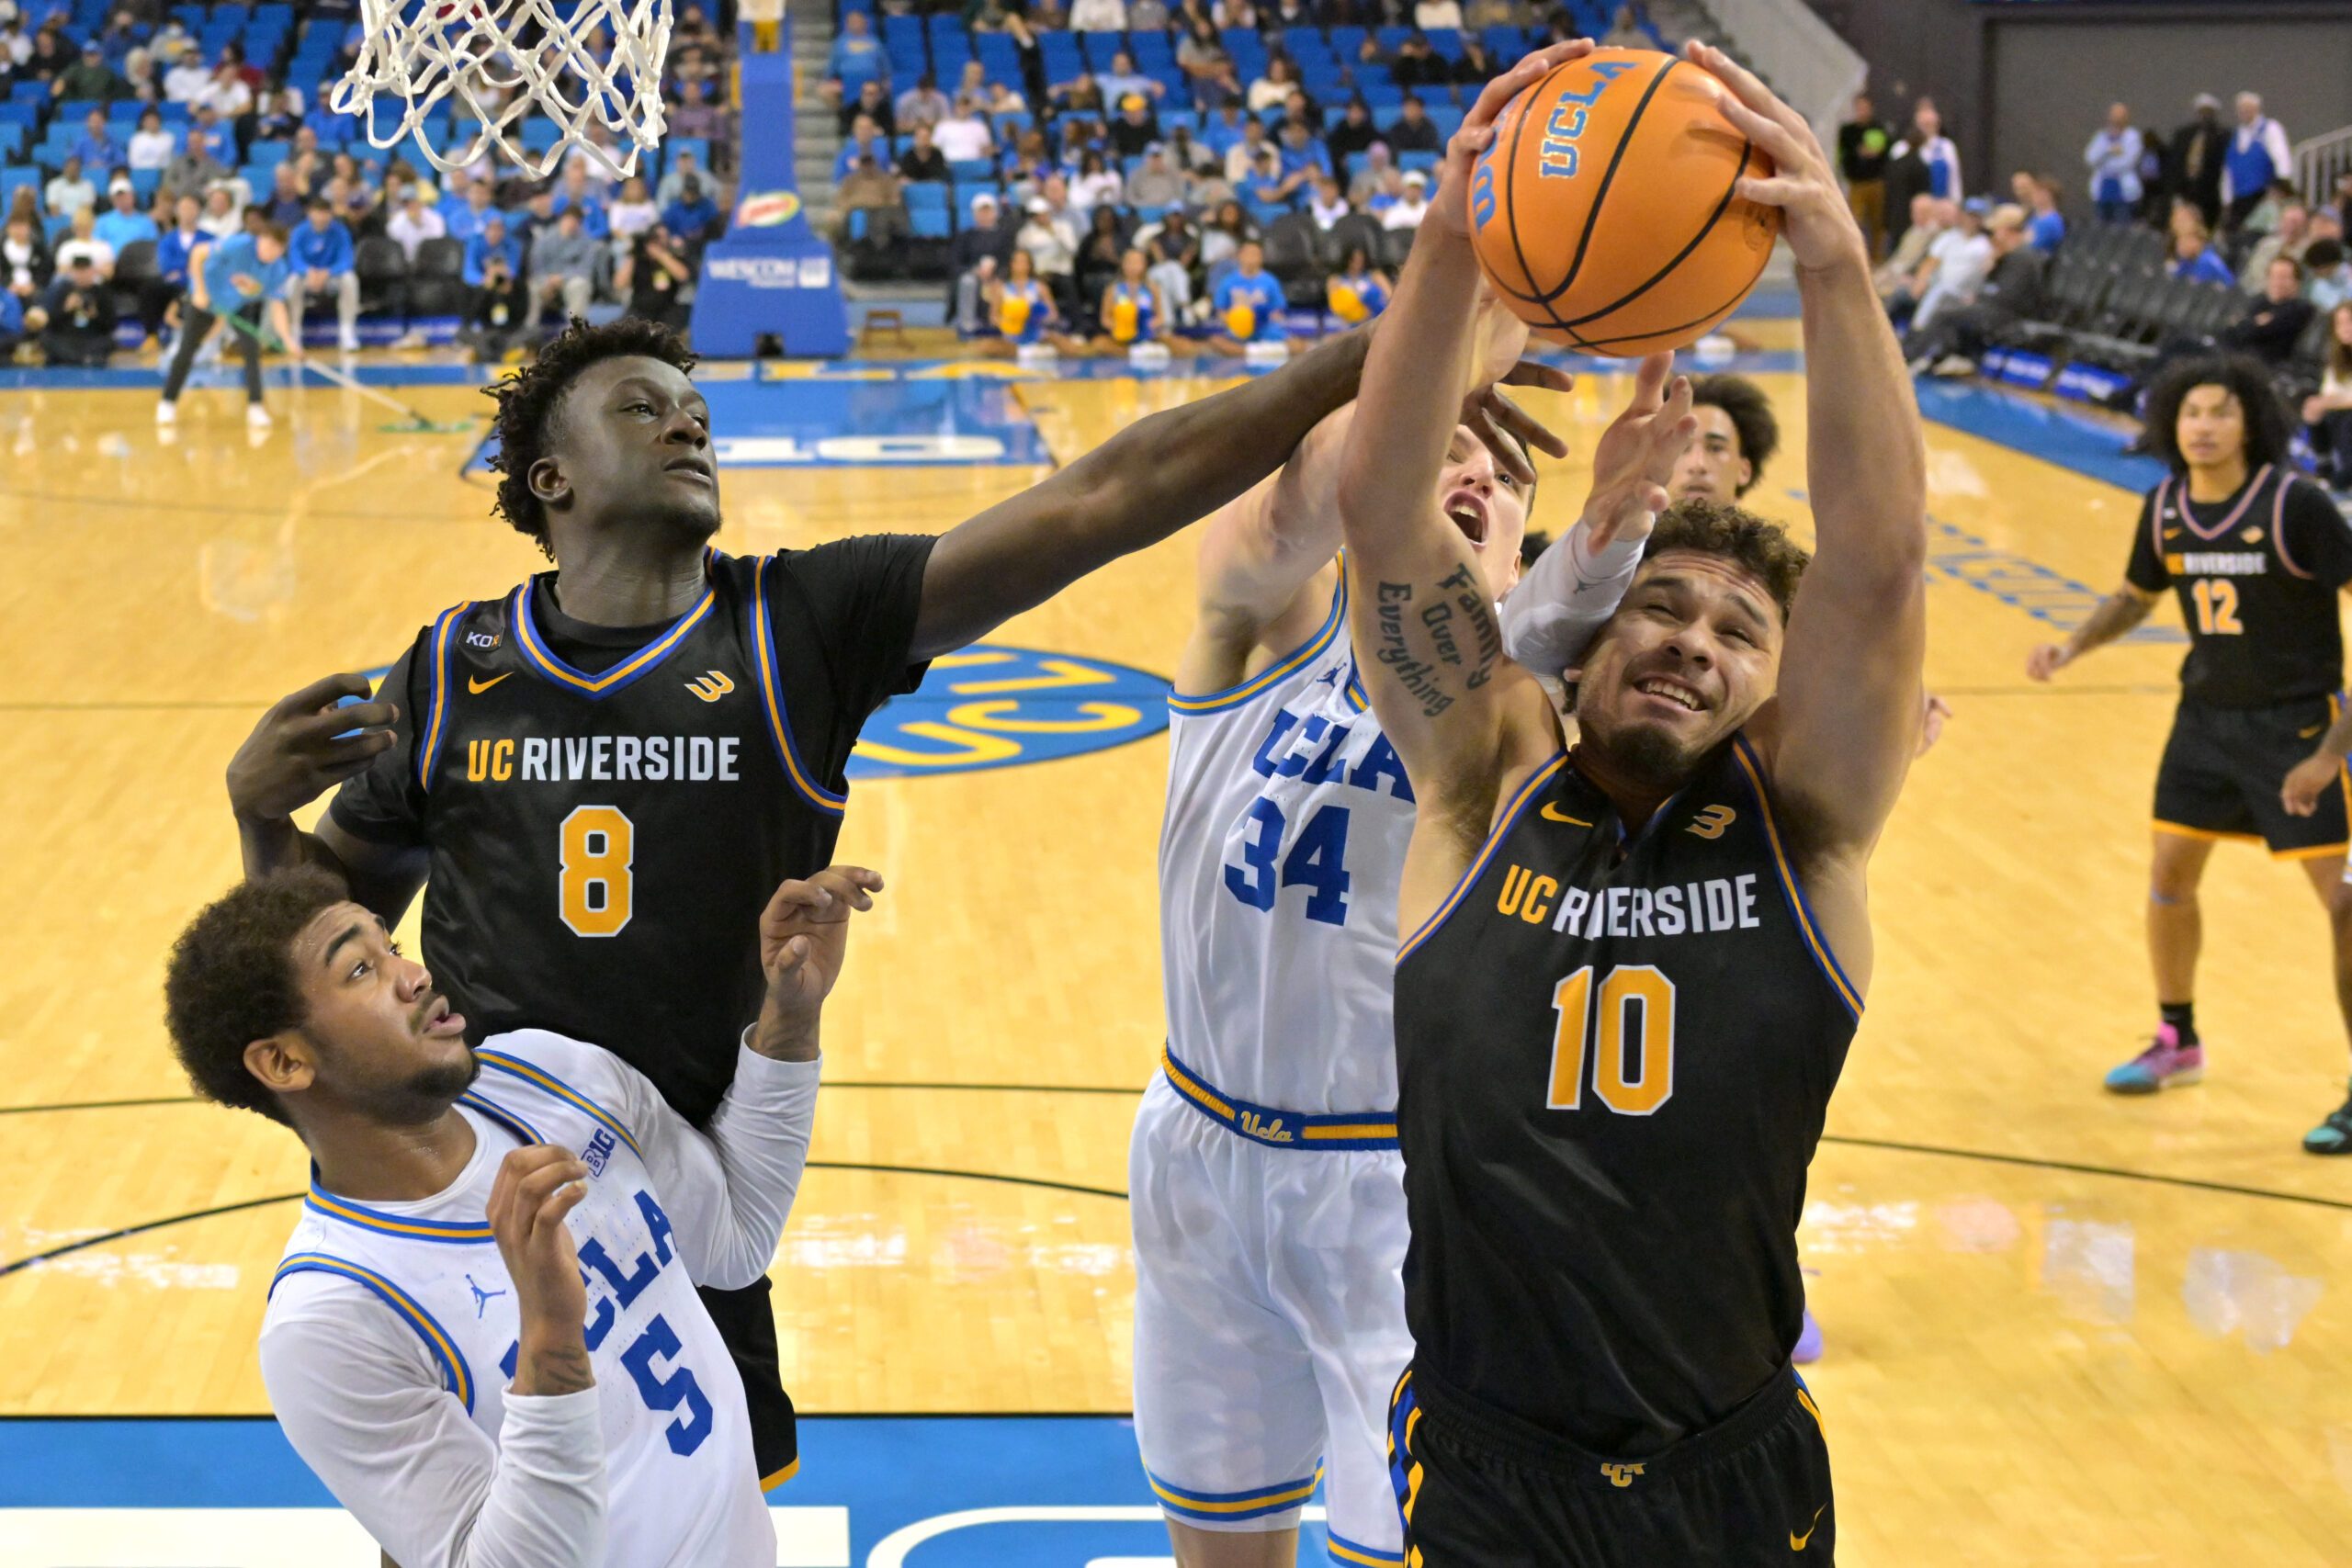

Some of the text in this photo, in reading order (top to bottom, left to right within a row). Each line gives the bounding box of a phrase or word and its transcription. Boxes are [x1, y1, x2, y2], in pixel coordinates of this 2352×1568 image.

[1539, 61, 1641, 179] UCLA
[1376, 580, 1456, 717] Everything
[1421, 600, 1463, 666] Over
[1436, 561, 1502, 692] Family
[2192, 578, 2244, 636] 12
[467, 735, 741, 782] UC RIVERSIDE
[558, 804, 635, 938] 8
[1224, 795, 1351, 927] 34
[1497, 863, 1559, 925] UC
[1545, 964, 1677, 1117] 10
[1240, 1110, 1295, 1143] Ucla
[499, 1189, 678, 1380] CLA
[619, 1313, 714, 1458] 5
